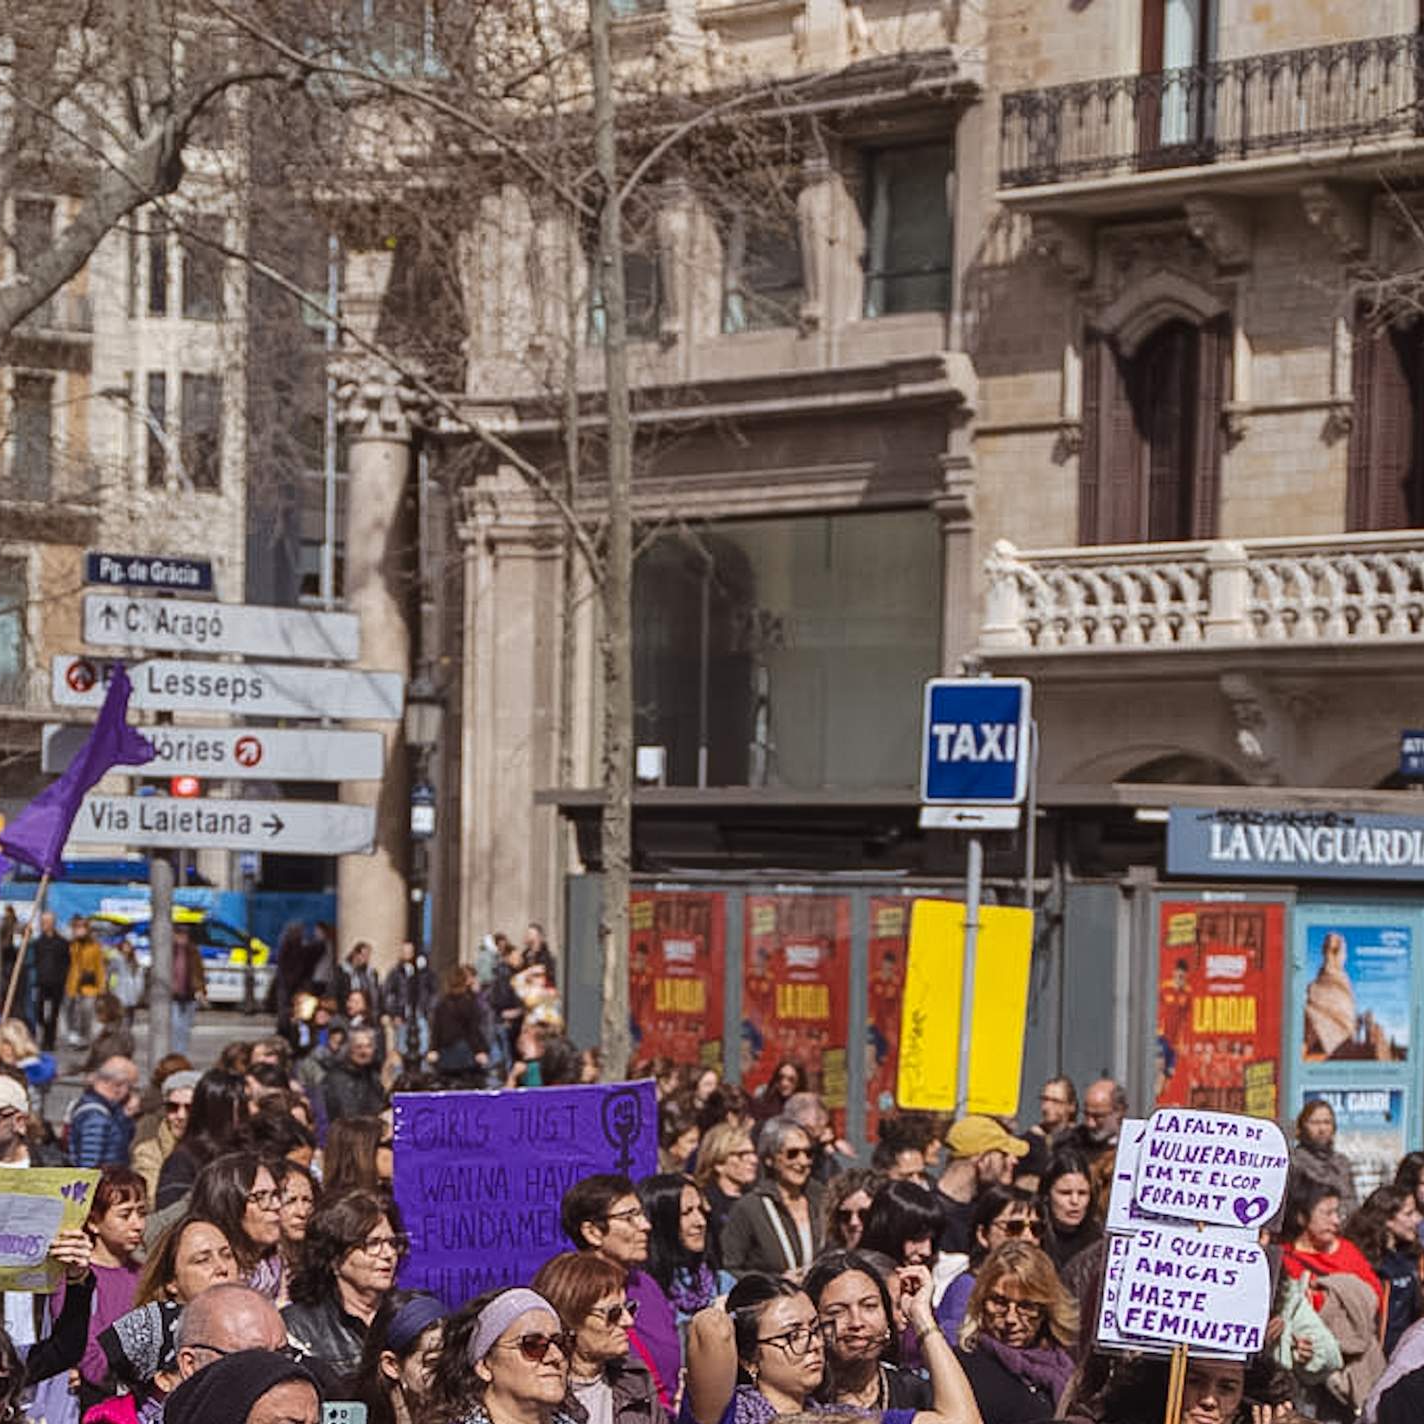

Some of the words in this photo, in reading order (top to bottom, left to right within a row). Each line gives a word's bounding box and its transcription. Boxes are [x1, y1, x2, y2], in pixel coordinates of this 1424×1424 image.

[98, 558, 126, 582] Pg.
[127, 561, 148, 580] de
[150, 560, 201, 586] Gràcia
[125, 603, 148, 633] C.
[154, 605, 224, 642] Aragó
[147, 665, 264, 705] Lesseps
[151, 733, 226, 763] lòries
[931, 722, 1017, 763] TAXI
[89, 803, 129, 831] Via
[138, 804, 253, 836] Laietana
[411, 1107, 491, 1150] GIRLS
[511, 1104, 580, 1144] JUST
[1154, 1113, 1180, 1133] LA
[1183, 1117, 1239, 1137] FALTA
[1245, 1126, 1264, 1141] DE
[417, 1166, 509, 1201] WANNA
[1145, 1164, 1173, 1182] EM
[1178, 1167, 1203, 1185] TE
[1208, 1171, 1230, 1188] EL
[1231, 1174, 1262, 1192] COR
[1139, 1184, 1227, 1210] FORADAT
[1138, 1230, 1162, 1249] SI
[1170, 1236, 1261, 1264] QUIERES
[1135, 1257, 1239, 1286] AMIGAS
[1129, 1282, 1207, 1312] HAZTE
[1125, 1308, 1260, 1348] FEMINISTA
